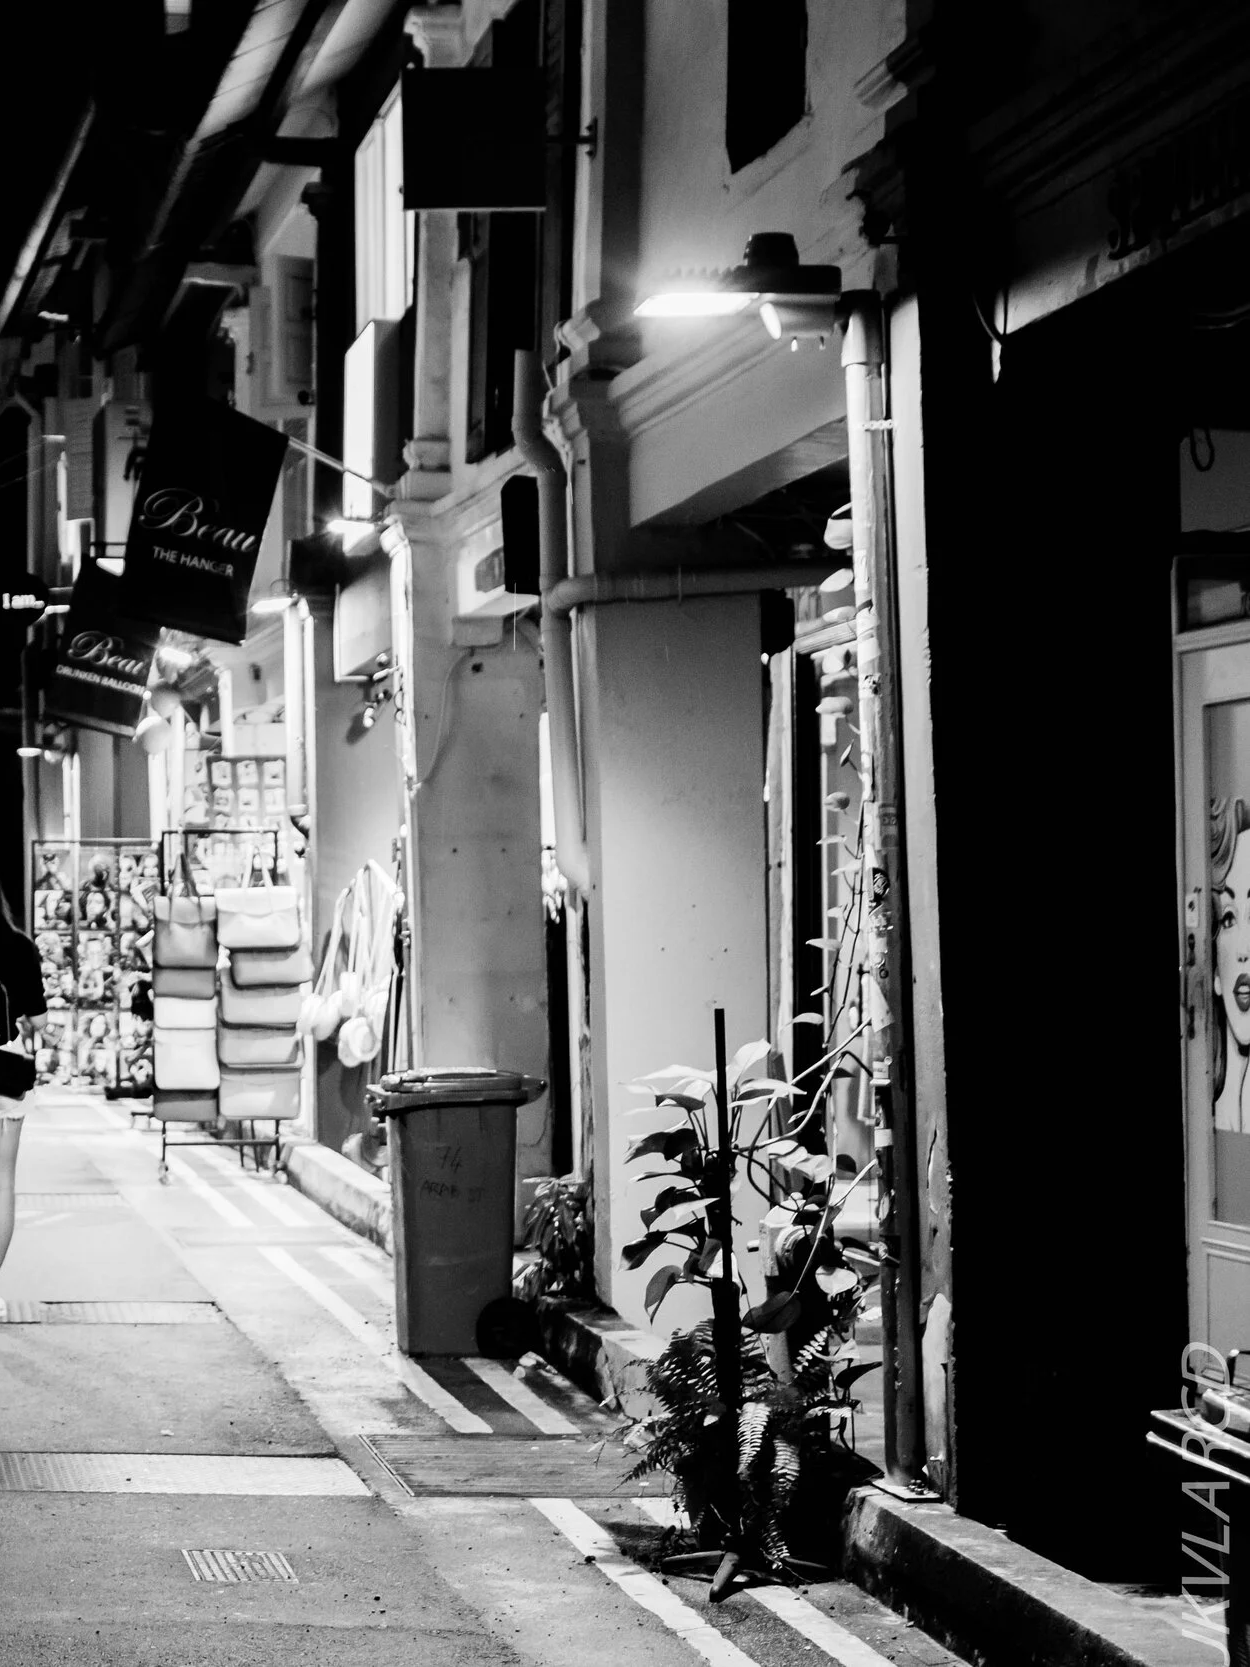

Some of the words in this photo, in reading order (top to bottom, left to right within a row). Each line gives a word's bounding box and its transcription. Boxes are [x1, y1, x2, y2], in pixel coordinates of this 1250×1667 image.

[138, 487, 258, 552] Beau
[152, 545, 178, 564] THE
[179, 553, 234, 578] HANGER
